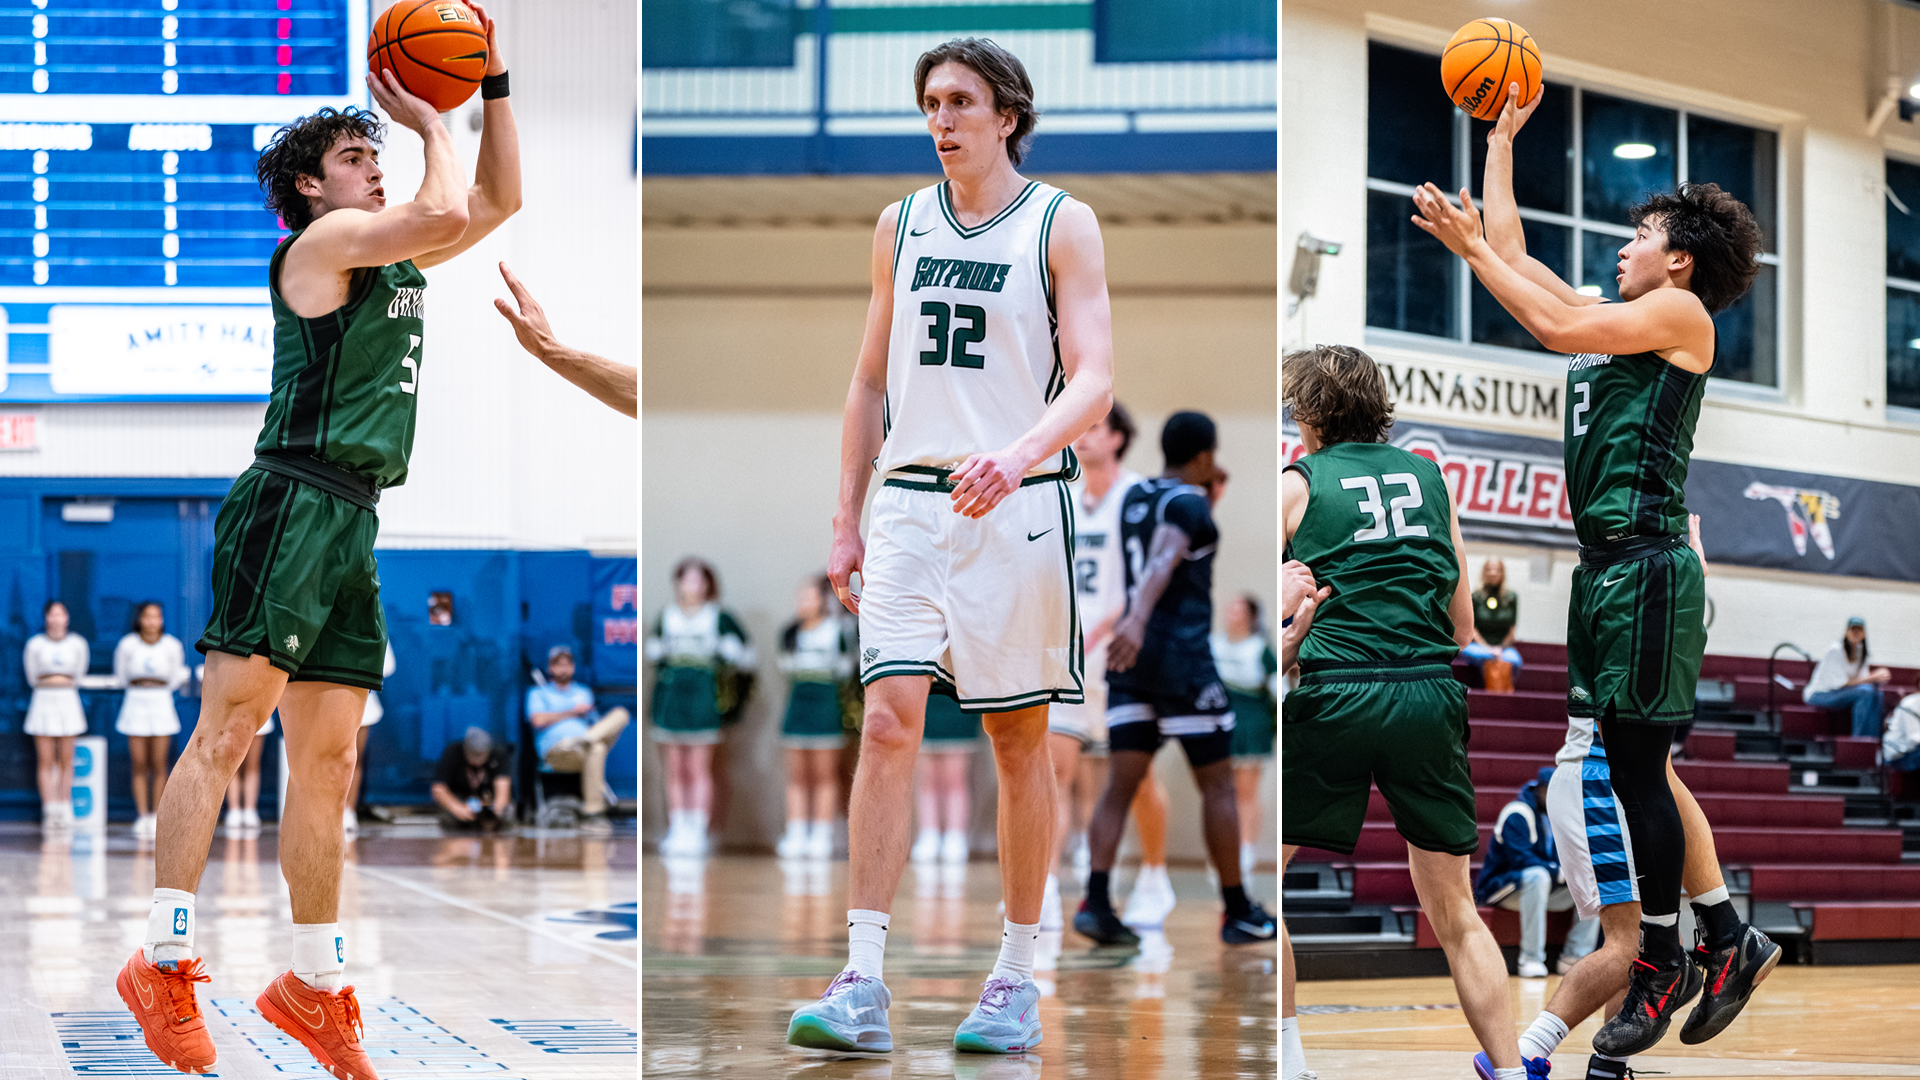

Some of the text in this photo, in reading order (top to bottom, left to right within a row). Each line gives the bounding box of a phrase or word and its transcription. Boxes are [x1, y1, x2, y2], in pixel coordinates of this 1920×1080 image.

[437, 7, 471, 22] ELI
[911, 256, 1013, 293] GRYPHONS
[128, 322, 270, 349] AMITY HAL
[920, 301, 986, 369] 32
[399, 333, 422, 395] 5
[1378, 363, 1559, 419] MNASIUM
[1573, 381, 1591, 437] 2
[1339, 473, 1430, 542] 32
[1411, 448, 1574, 522] OLLE
